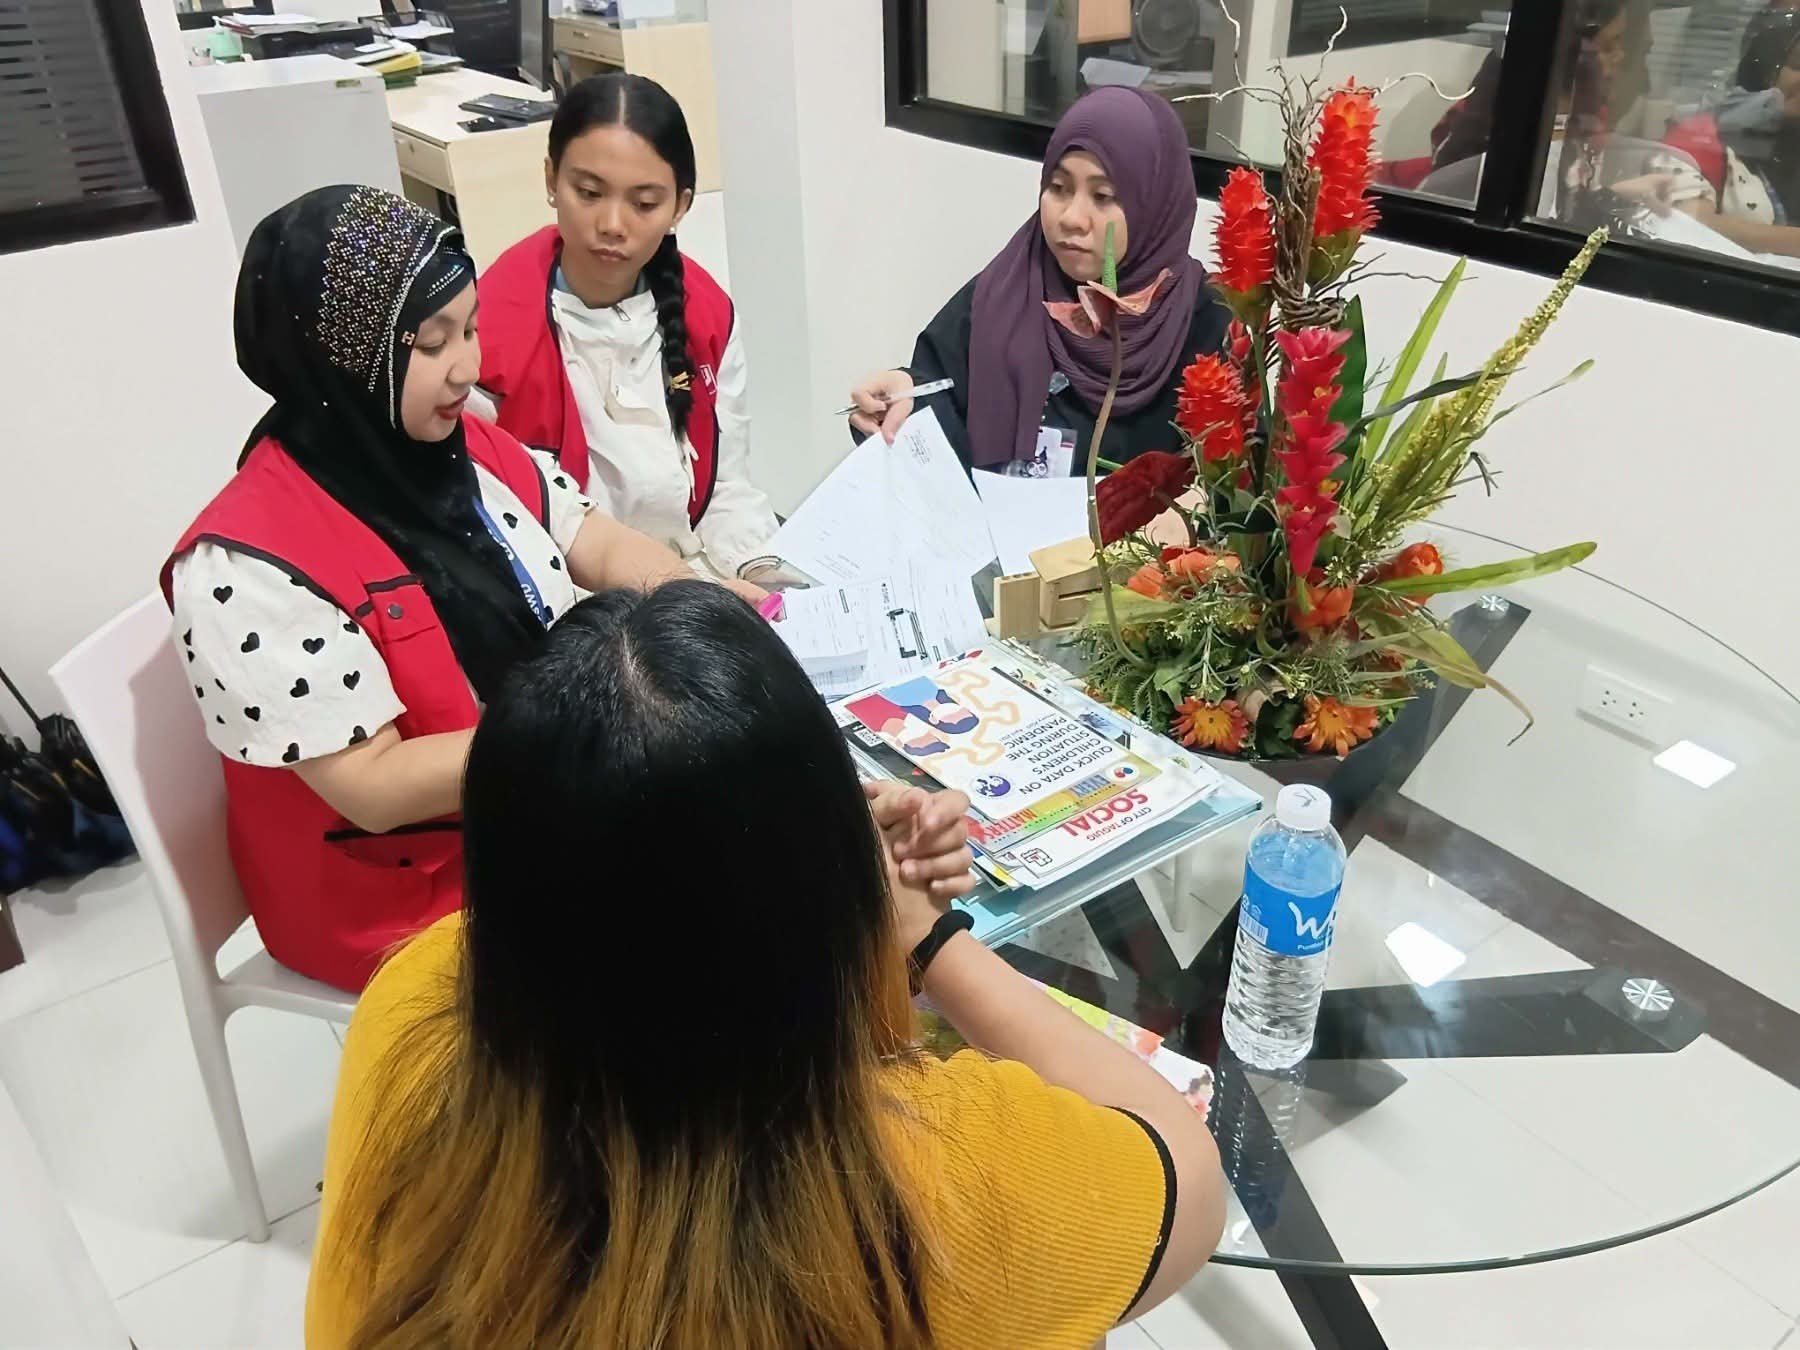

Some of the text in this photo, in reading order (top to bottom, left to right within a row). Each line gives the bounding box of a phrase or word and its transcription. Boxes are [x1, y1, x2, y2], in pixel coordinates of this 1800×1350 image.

[1004, 717, 1067, 749] PANDEMIC
[1028, 730, 1090, 764] SITUATION
[1030, 723, 1079, 748] DURING
[1005, 747, 1032, 761] THE
[1019, 745, 1113, 795] QUICK DATA ON
[1032, 738, 1101, 774] CHILDREN'S
[1055, 788, 1149, 837] SOCIAL
[1086, 807, 1152, 842] CITY OF TAGUIG
